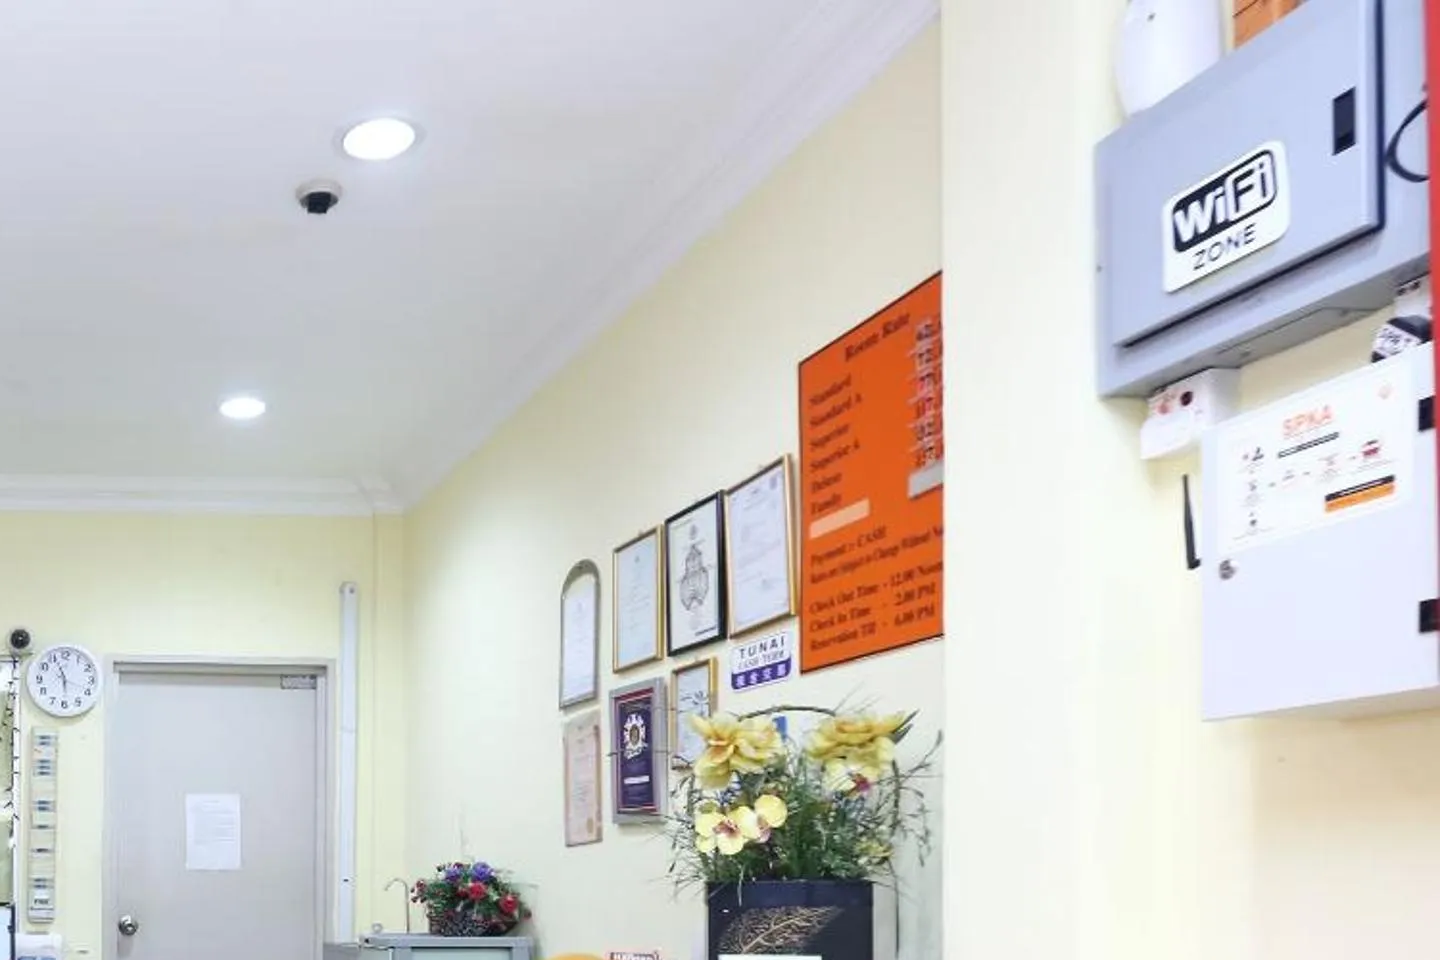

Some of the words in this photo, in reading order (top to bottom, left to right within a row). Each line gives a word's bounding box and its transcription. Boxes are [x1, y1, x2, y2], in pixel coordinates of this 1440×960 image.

[1173, 160, 1269, 243] WiFi
[1193, 222, 1257, 271] ZONE
[60, 650, 71, 661] 12
[740, 635, 785, 659] TUNAI
